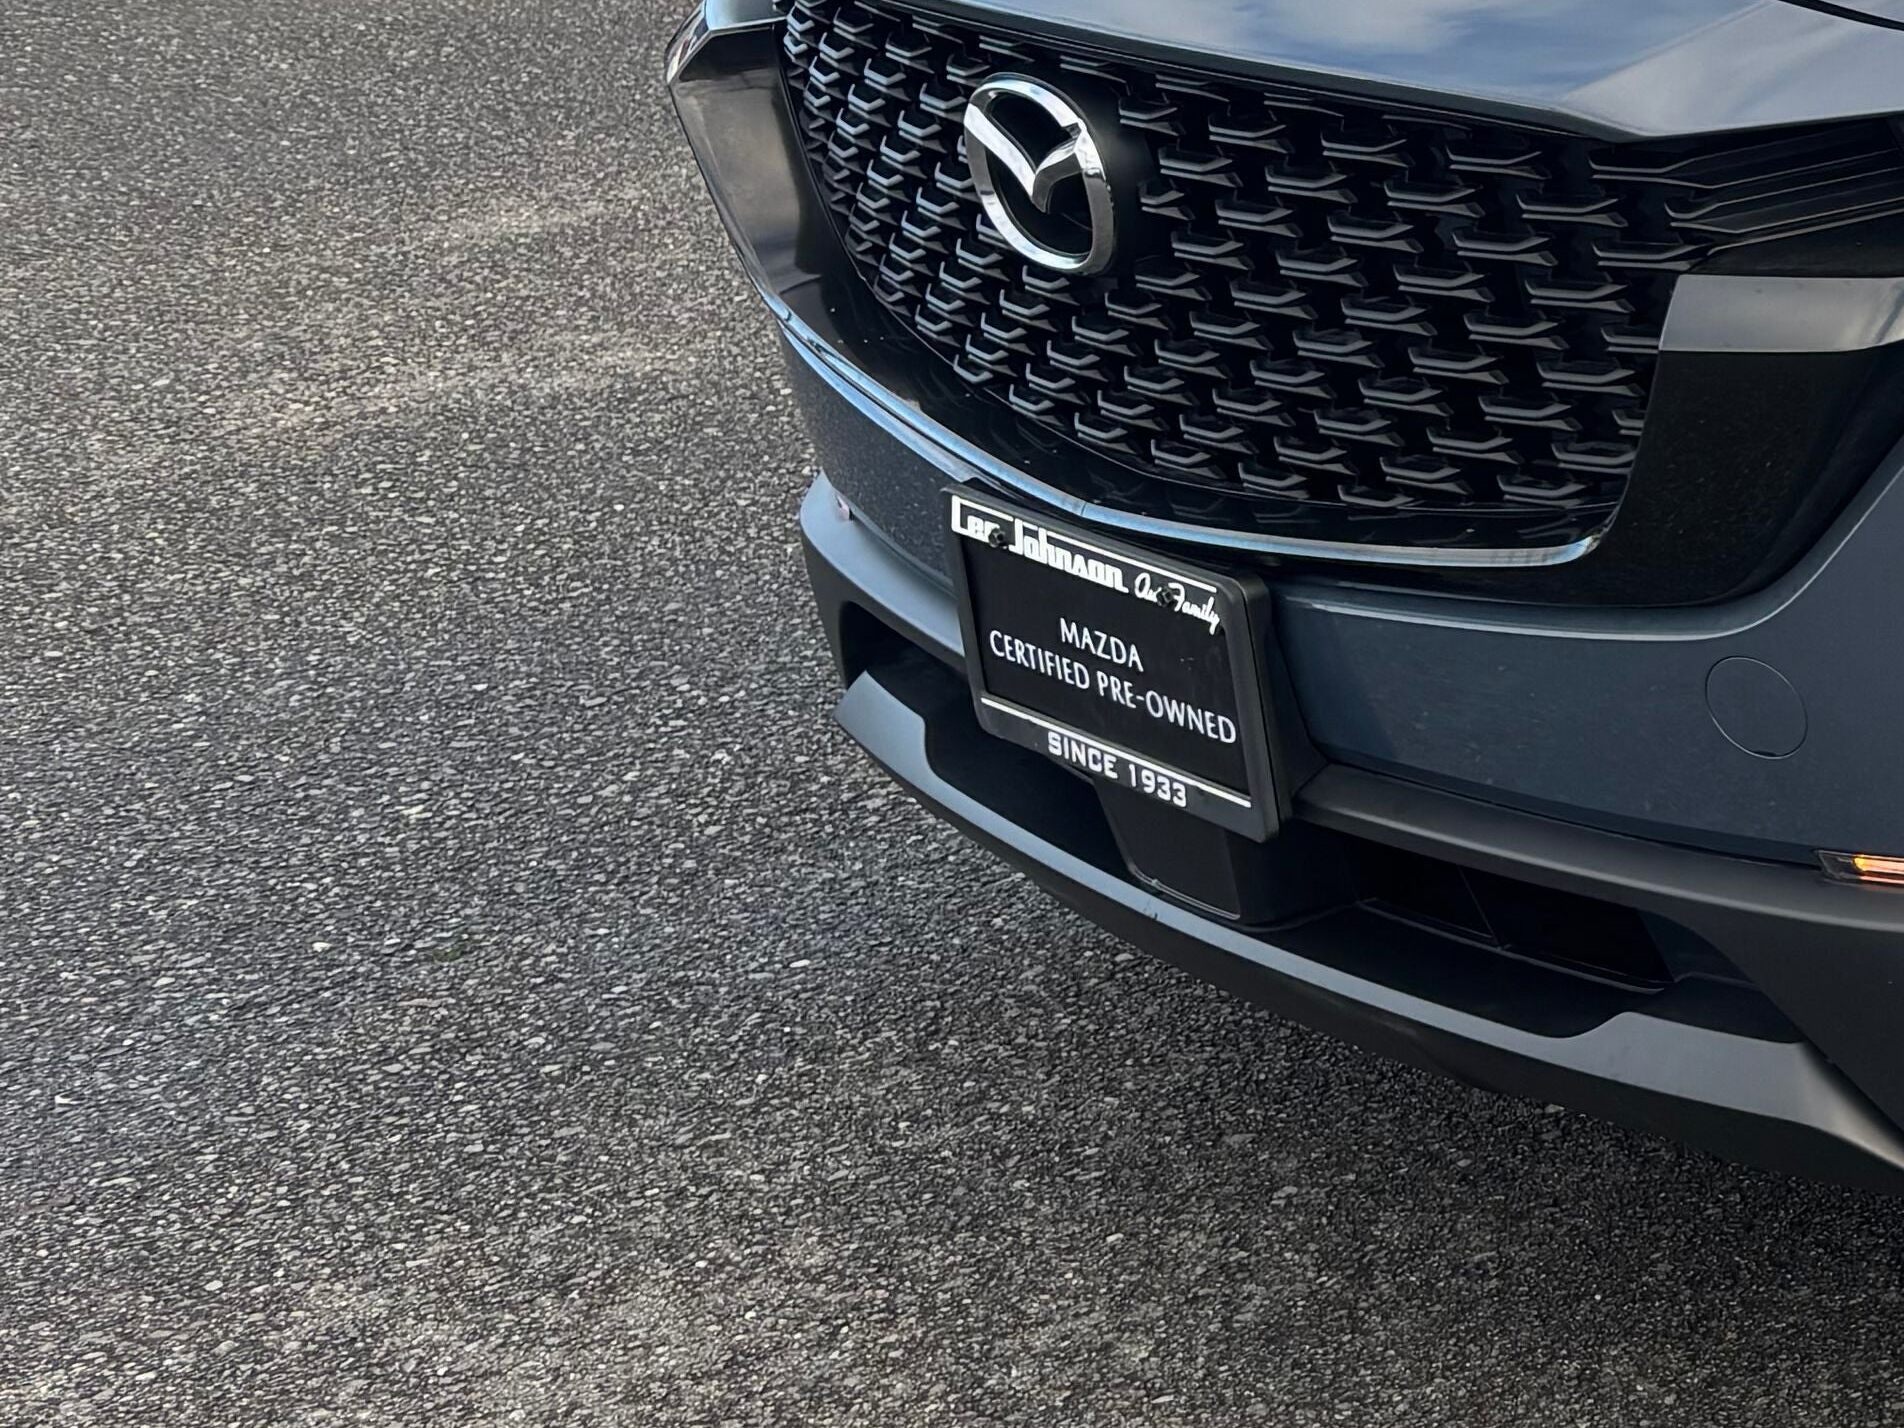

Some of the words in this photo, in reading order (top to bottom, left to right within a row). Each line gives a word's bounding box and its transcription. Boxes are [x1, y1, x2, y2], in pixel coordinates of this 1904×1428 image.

[1008, 518, 1130, 594] Johnson
[1168, 582, 1221, 635] Family
[989, 629, 1090, 690] CERTIFIED
[1096, 670, 1237, 745] PRE-OWNED
[1059, 616, 1144, 672] MAZDA
[1047, 730, 1119, 780] SINCE
[1128, 763, 1187, 809] 1933
